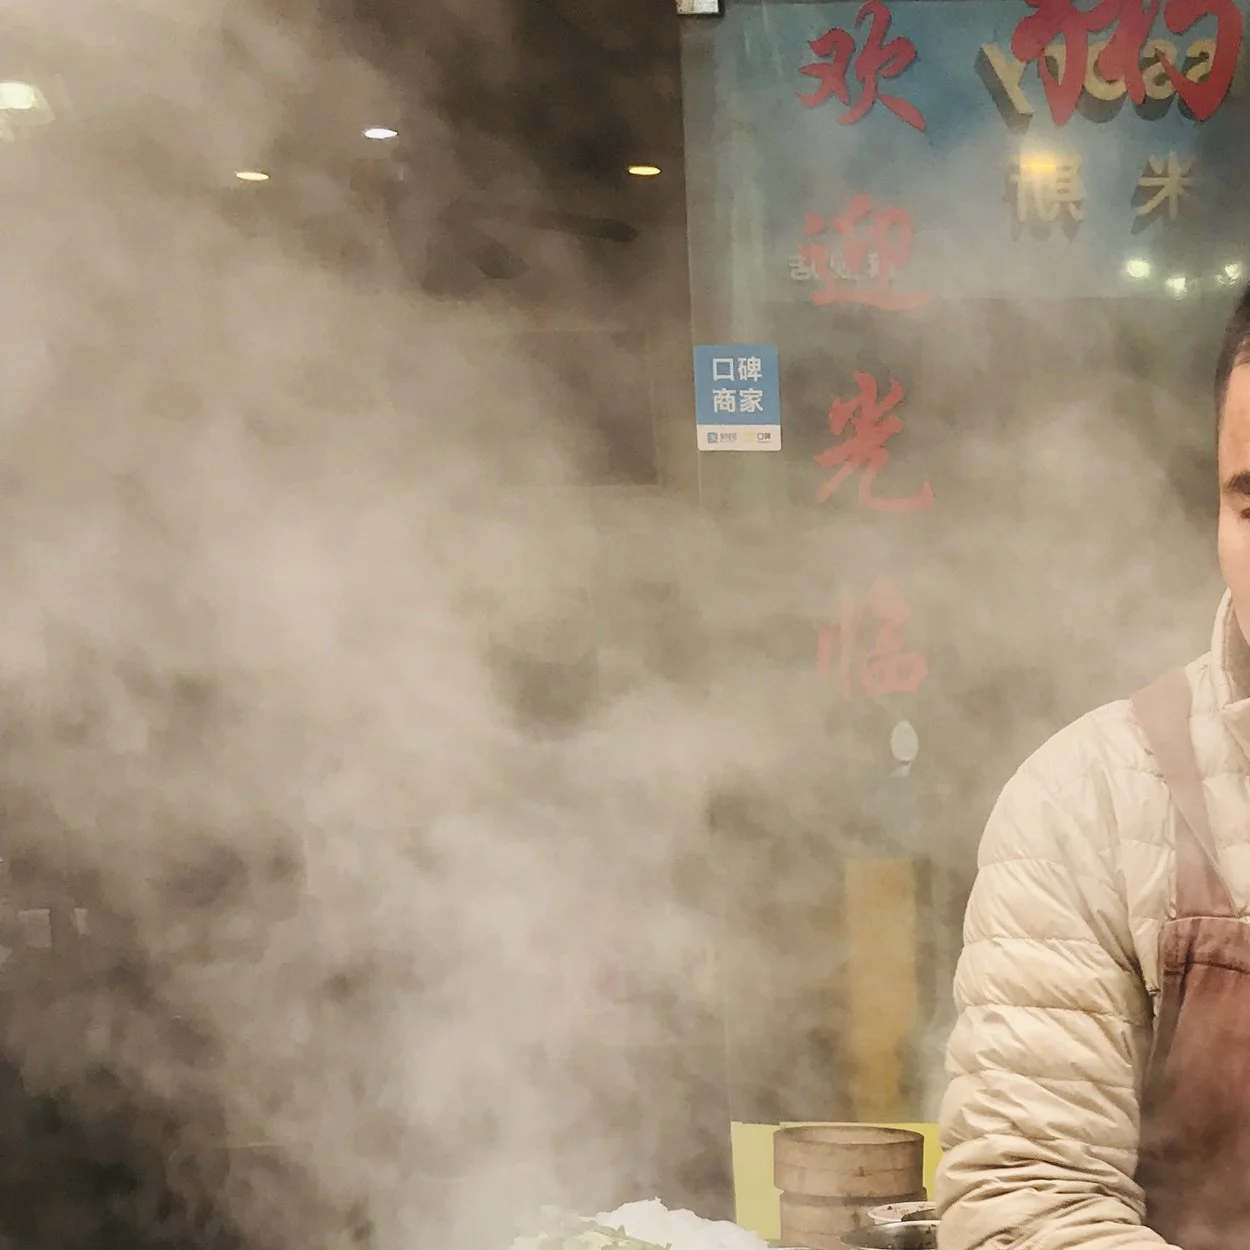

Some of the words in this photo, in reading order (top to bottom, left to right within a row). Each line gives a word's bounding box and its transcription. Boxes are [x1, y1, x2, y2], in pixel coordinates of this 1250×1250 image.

[798, 0, 936, 702] 欢迎光临
[712, 356, 763, 382] 口碑
[712, 387, 764, 413] 商家
